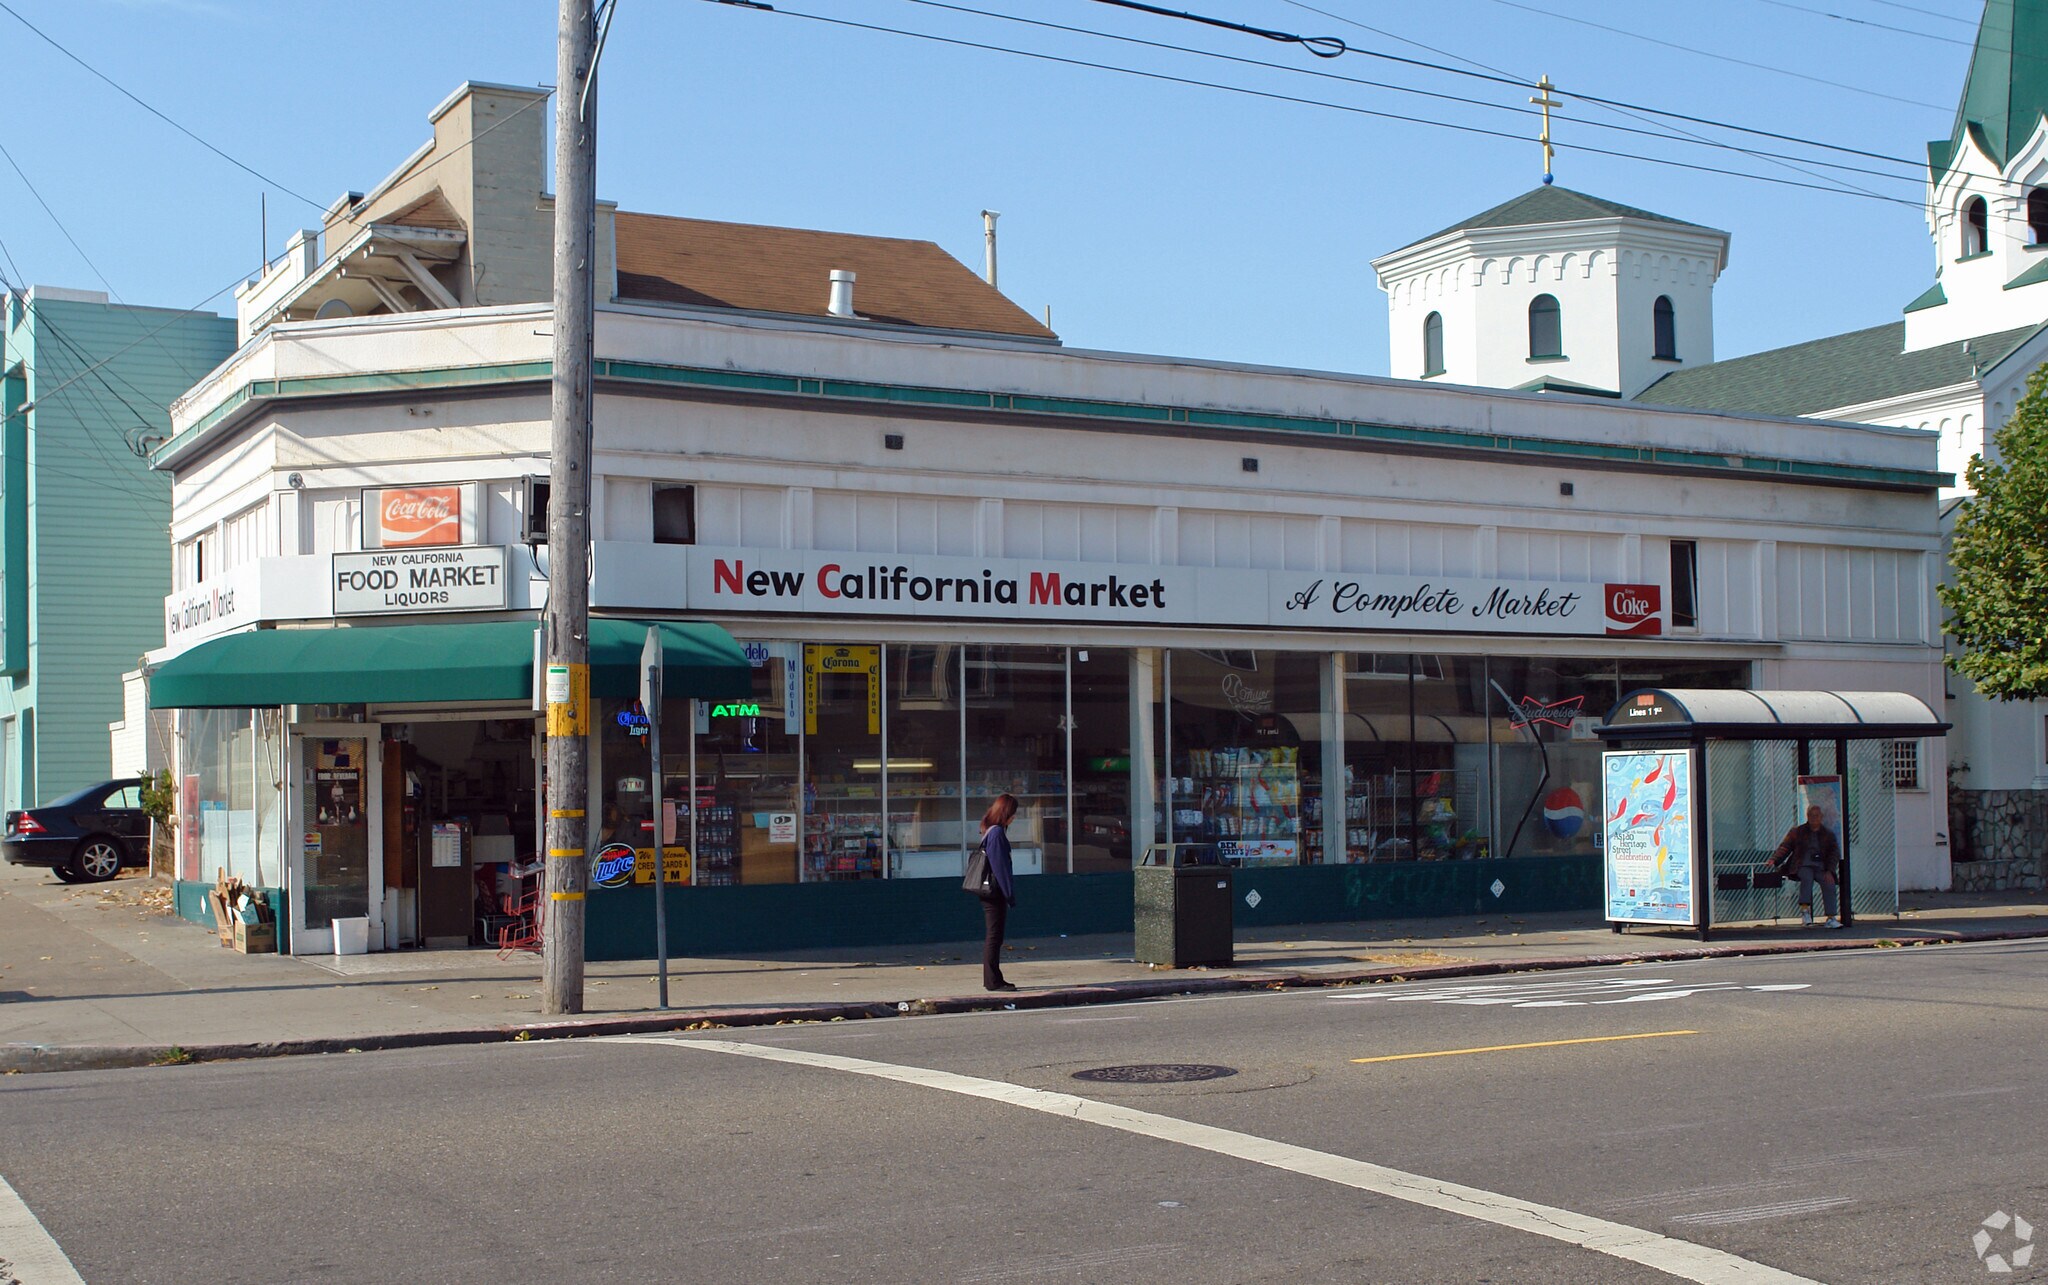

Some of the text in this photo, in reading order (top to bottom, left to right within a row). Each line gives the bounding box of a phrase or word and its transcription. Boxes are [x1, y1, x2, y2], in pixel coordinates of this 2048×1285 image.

[372, 553, 464, 566] NEW CALIFORNIA
[338, 565, 500, 591] FOOD MARKET
[714, 559, 1165, 609] New California Market
[385, 591, 449, 607] LIQUORS
[1286, 579, 1581, 620] A Complete Market
[1613, 591, 1649, 616] Coke
[182, 595, 210, 630] California
[212, 586, 234, 620] Market
[740, 643, 769, 660] delo
[822, 656, 860, 671] Corona
[806, 664, 815, 714] Corona
[869, 665, 878, 715] Corona
[711, 703, 760, 717] ATM
[1629, 708, 1647, 717] Lines
[617, 711, 651, 726] Coro
[629, 724, 648, 736] Light
[622, 781, 642, 789] ATM
[1612, 845, 1631, 856] Street
[1619, 840, 1647, 849] Heritage
[663, 851, 687, 859] elcome
[593, 856, 635, 882] Lite
[637, 861, 656, 870] CRED
